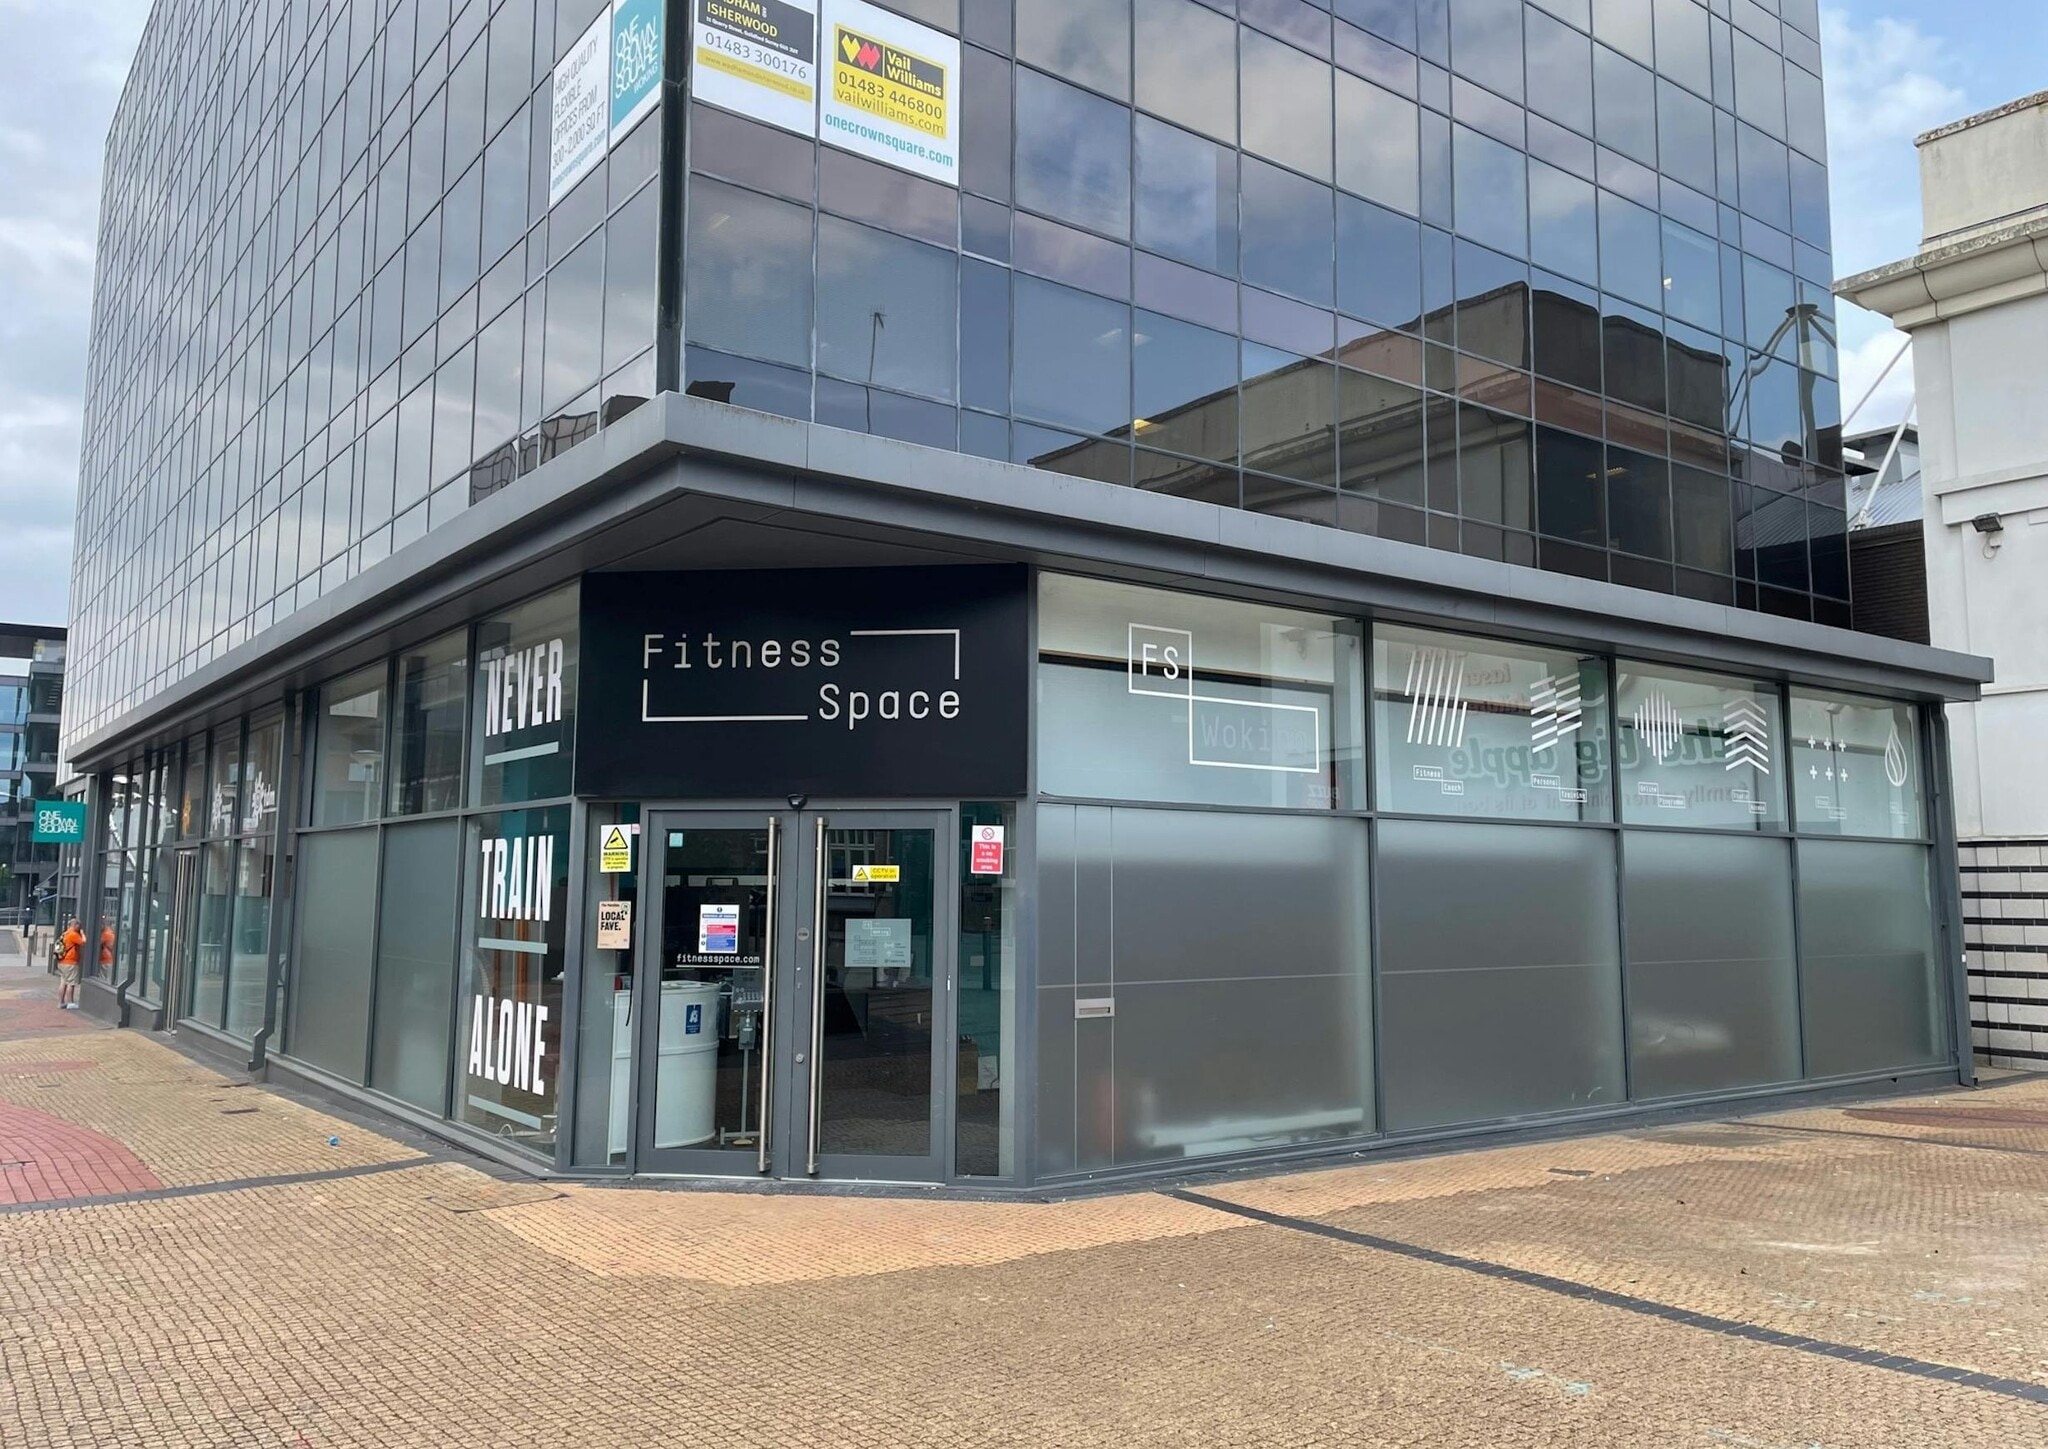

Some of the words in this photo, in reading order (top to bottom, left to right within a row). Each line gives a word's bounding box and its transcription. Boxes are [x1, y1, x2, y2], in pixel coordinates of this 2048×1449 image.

[616, 14, 639, 56] ONE
[707, 1, 778, 37] ISHERWOOD
[616, 15, 658, 77] CROWN
[705, 32, 750, 58] 01483
[754, 49, 807, 79] 300176
[886, 51, 911, 70] Vail
[555, 68, 569, 98] HIGH
[571, 36, 598, 79] QUALITY
[616, 44, 658, 99] SQUARE
[634, 61, 658, 94] WOKING
[886, 65, 942, 97] Williams
[554, 78, 581, 123] FLEXIBLE
[837, 88, 944, 135] vailwilliams.com
[839, 71, 885, 99] 01483
[889, 91, 943, 120] 446800
[553, 106, 577, 146] OFFICES
[578, 84, 597, 119] FROM
[586, 111, 596, 135] SQ
[597, 100, 606, 125] FT
[825, 113, 953, 167] onecrownsquare.com
[643, 632, 841, 669] Fitness
[1142, 643, 1179, 681] FS
[486, 638, 563, 737] NEVER
[818, 683, 960, 730] Space
[1415, 767, 1441, 778] Fitness
[1443, 782, 1462, 793] Coach
[1533, 776, 1558, 787] Personal
[1561, 790, 1586, 800] Training
[39, 810, 61, 819] ONE
[39, 818, 78, 827] CROWN
[39, 825, 79, 833] SQUARE
[481, 835, 553, 922] TRAIN
[600, 922, 621, 931] FAVE.
[601, 911, 625, 920] LOCAL
[677, 953, 760, 965] fitnessspace.com
[468, 994, 548, 1096] ALONE
